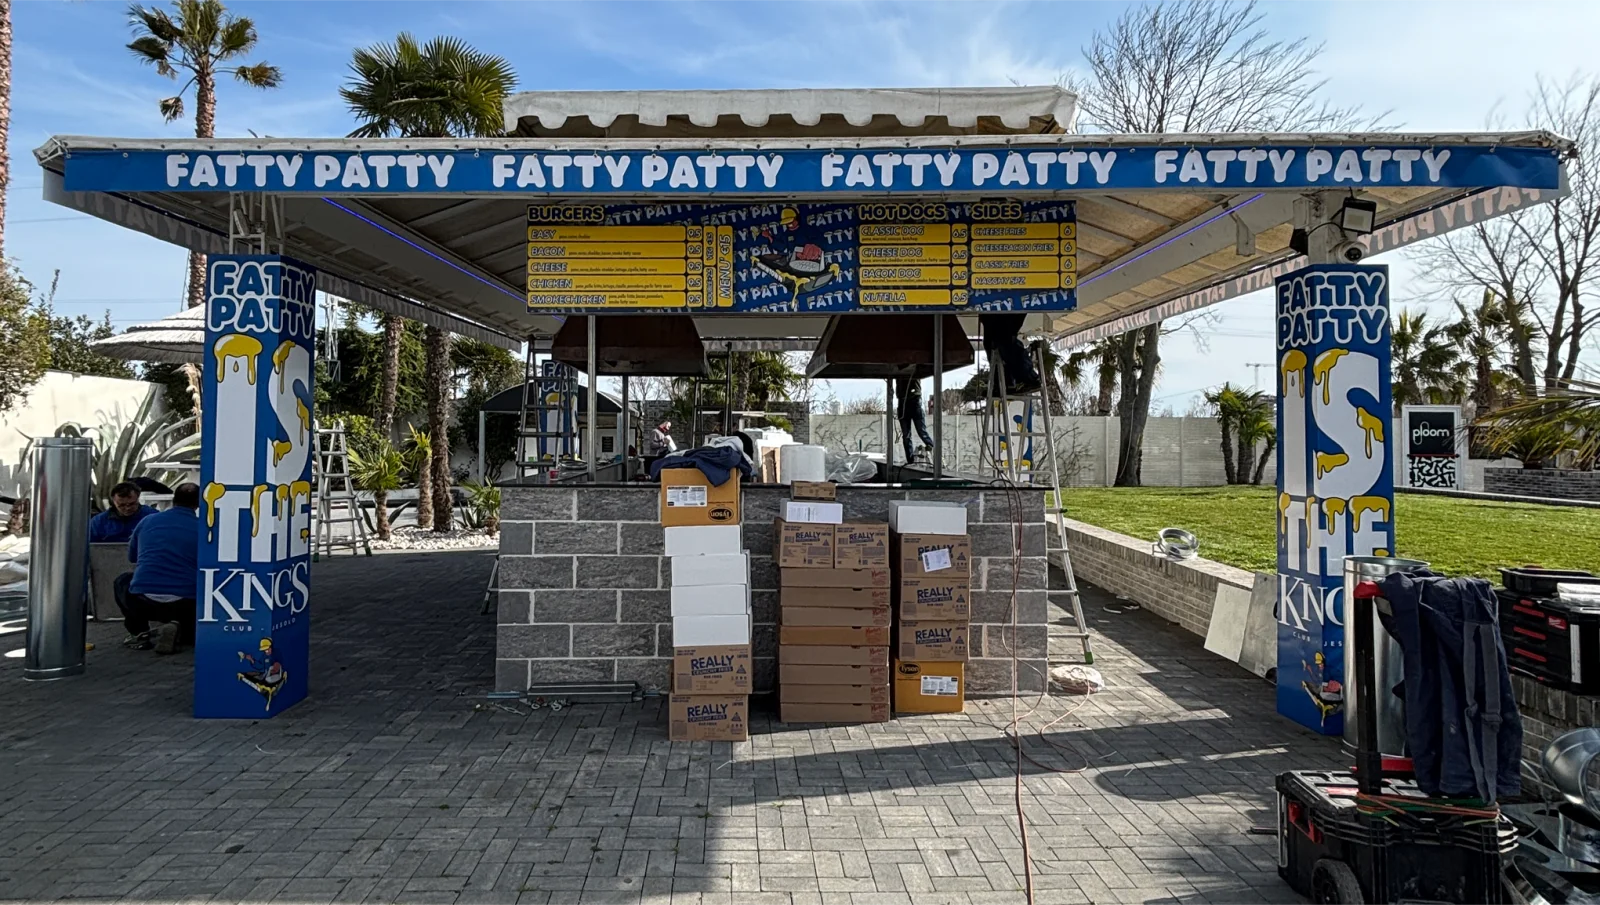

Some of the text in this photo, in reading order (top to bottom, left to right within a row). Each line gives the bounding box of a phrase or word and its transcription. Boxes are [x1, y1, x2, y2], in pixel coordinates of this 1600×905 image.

[166, 154, 455, 188] FATTY PATTY
[492, 155, 784, 188] FATTY PATTY
[821, 151, 1117, 187] FATTY PATTY
[1154, 149, 1451, 183] FATTY PATTY
[528, 206, 604, 221] BURGERS
[806, 206, 855, 226] FATTY
[860, 204, 946, 220] HOT DOGS
[972, 203, 1021, 219] SIDES
[531, 229, 556, 239] EASY
[861, 226, 967, 239] CLASSIC DOG 6.5
[974, 225, 1072, 236] CHEESE FRIES 6
[531, 246, 566, 256] BACON
[719, 234, 731, 255] €15
[1031, 243, 1054, 252] FRIES
[1064, 242, 1072, 253] 6
[862, 248, 899, 257] CHEESE
[900, 248, 923, 257] DOG
[952, 250, 967, 260] 6.5
[531, 262, 568, 272] CHEESE
[975, 259, 1072, 269] CLASSIC FRIES 6
[862, 269, 896, 278] BACON
[898, 269, 921, 278] DOG
[952, 271, 967, 280] 6.5
[1064, 275, 1072, 286] 6
[210, 261, 315, 305] FATTY
[530, 279, 573, 289] CHICKEN
[530, 295, 606, 304] SMOKECHICKEN
[806, 288, 855, 310] FATTY
[863, 293, 968, 302] NUTELLA 6.5
[1020, 288, 1070, 309] FATTY
[1277, 271, 1386, 317] FATTY
[207, 297, 314, 339] PATTY
[1277, 305, 1388, 350] PATTY
[213, 334, 310, 485] IS
[1281, 348, 1385, 498] IS
[1412, 421, 1449, 445] ploom
[203, 481, 311, 562] THE
[795, 532, 821, 541] REALLY
[849, 532, 875, 541] REALLY
[1278, 492, 1391, 577] THE
[917, 587, 953, 599] REALLY
[272, 617, 296, 631] JESOLO
[915, 628, 952, 640] REALLY
[691, 655, 734, 670] REALLY
[687, 704, 728, 717] REALLY
